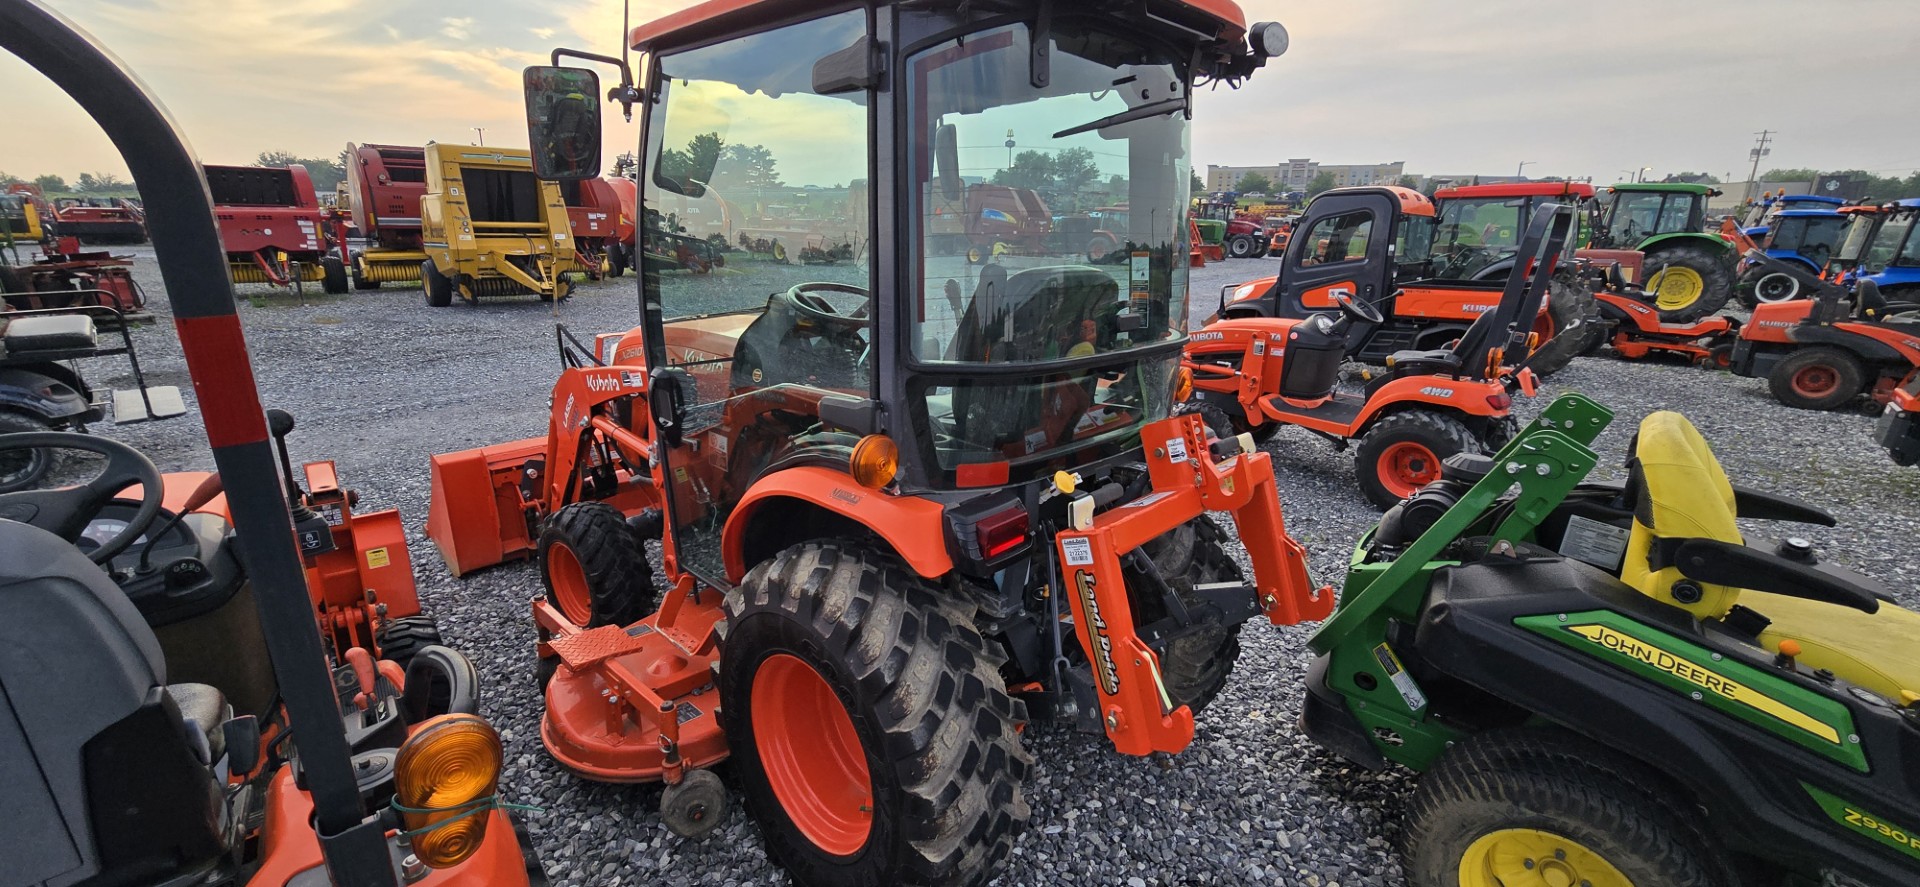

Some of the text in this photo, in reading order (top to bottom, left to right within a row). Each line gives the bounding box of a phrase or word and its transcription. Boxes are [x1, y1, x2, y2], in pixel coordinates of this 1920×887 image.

[1462, 303, 1497, 314] KUB
[1189, 331, 1224, 342] KUBOTA
[586, 373, 621, 392] Kubota
[1419, 385, 1455, 399] 4WD
[1084, 573, 1120, 695] Land Pride
[1590, 628, 1738, 698] JOHN DEERE
